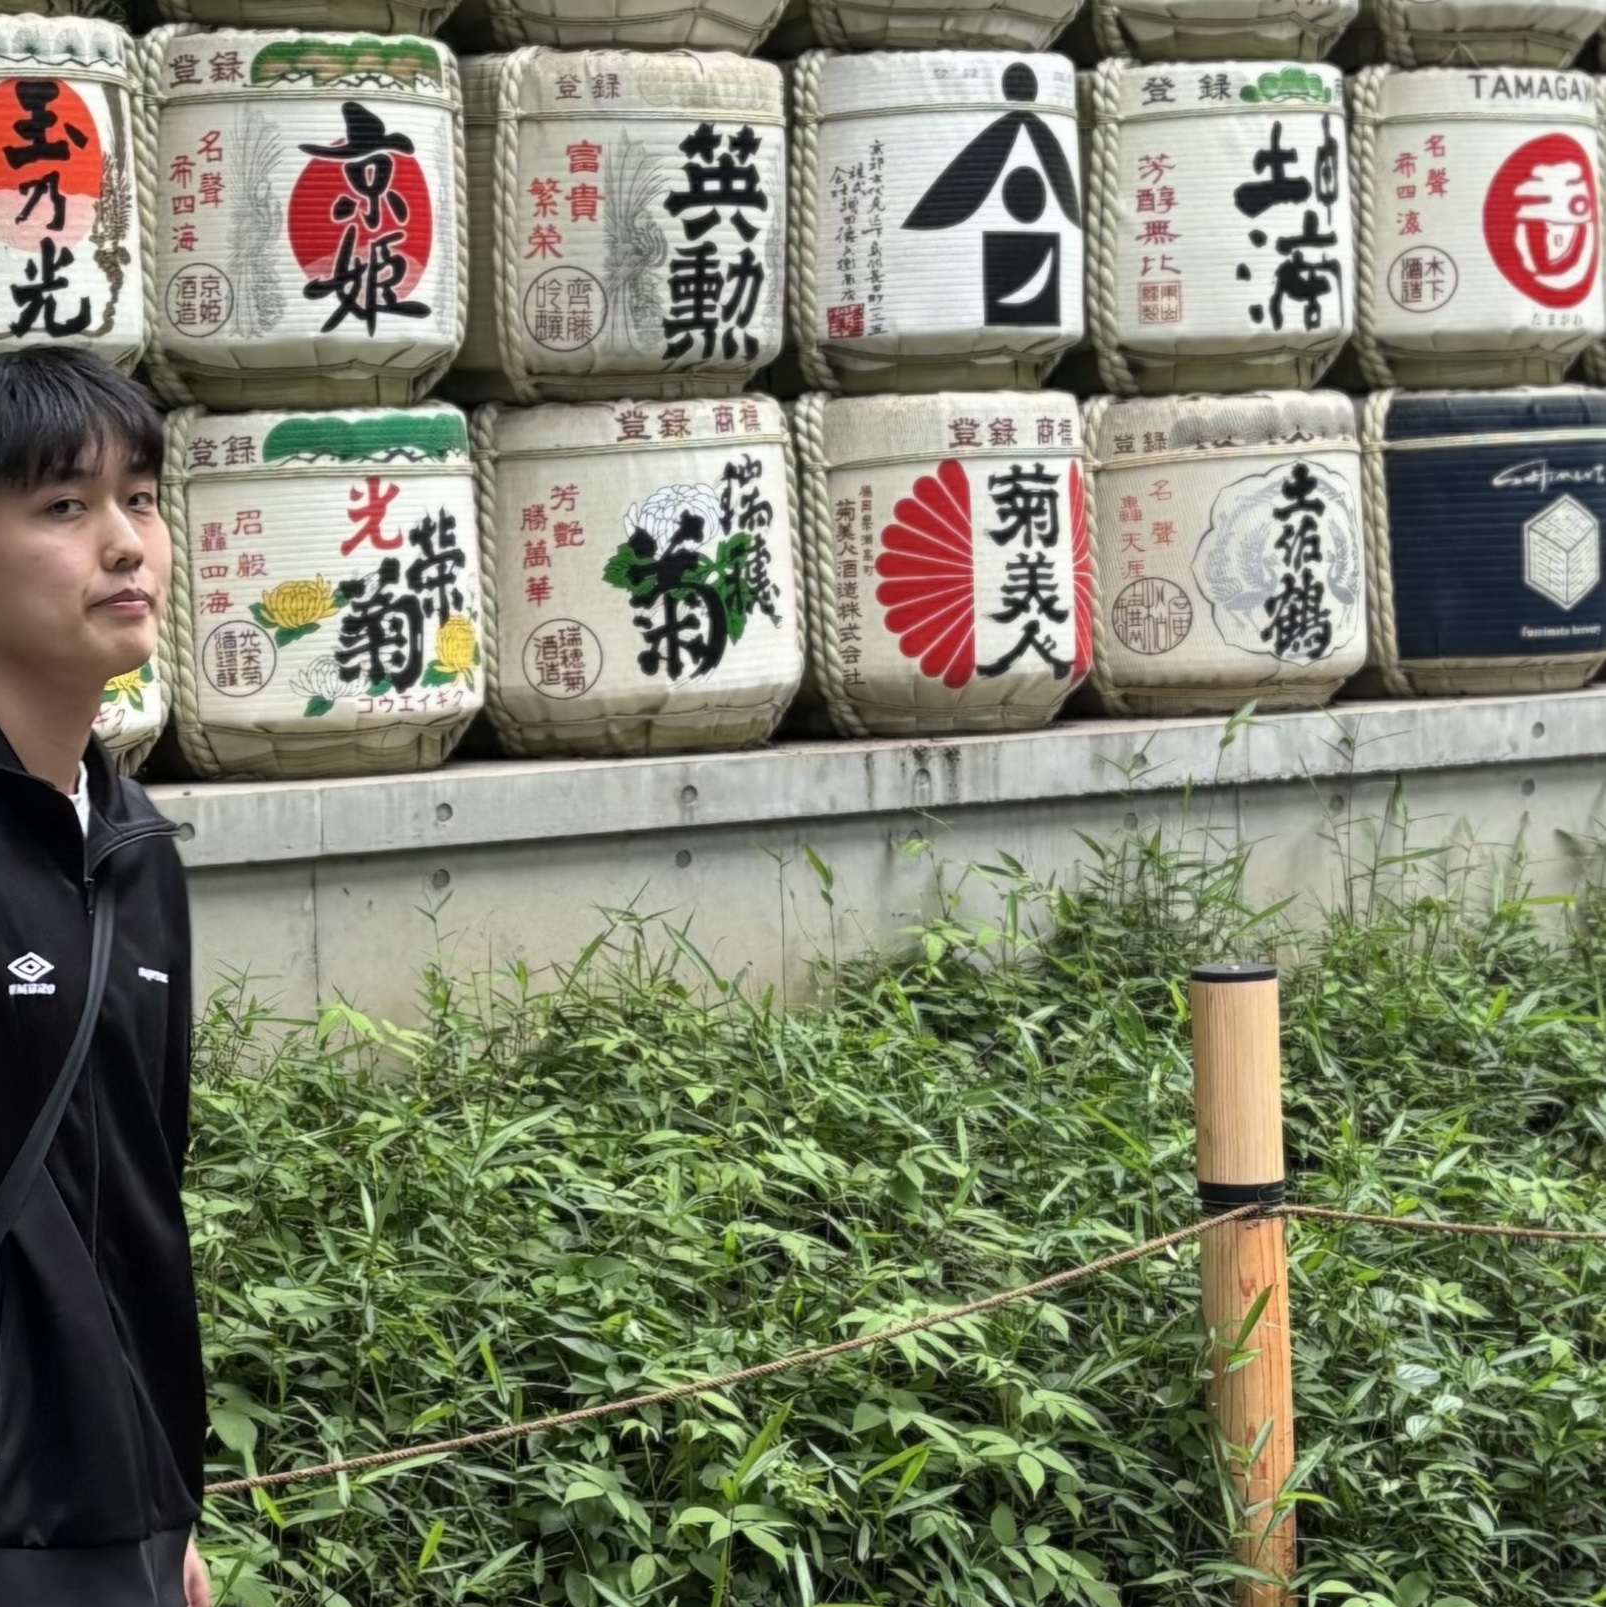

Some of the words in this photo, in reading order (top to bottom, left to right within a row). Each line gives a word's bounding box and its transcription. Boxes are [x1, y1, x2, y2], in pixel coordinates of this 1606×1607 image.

[168, 51, 244, 88] 登録
[554, 73, 621, 100] 登録
[1141, 73, 1232, 105] 登録
[564, 140, 605, 223] 富貴
[2, 80, 92, 339] 玉乃光
[298, 101, 432, 338] 京姫
[1135, 153, 1182, 277] 芳醇無比
[174, 274, 199, 326] 酒造
[1424, 255, 1446, 303] 木下
[615, 409, 691, 442] 登録
[947, 416, 1018, 449] 登録
[1114, 431, 1167, 455] 登録
[188, 436, 257, 470] 登録
[975, 462, 1075, 680] 菊美人
[1260, 462, 1332, 660] 土佐鶴
[835, 498, 867, 688] 菊美人酒造株式会社
[533, 635, 560, 687] 酒造
